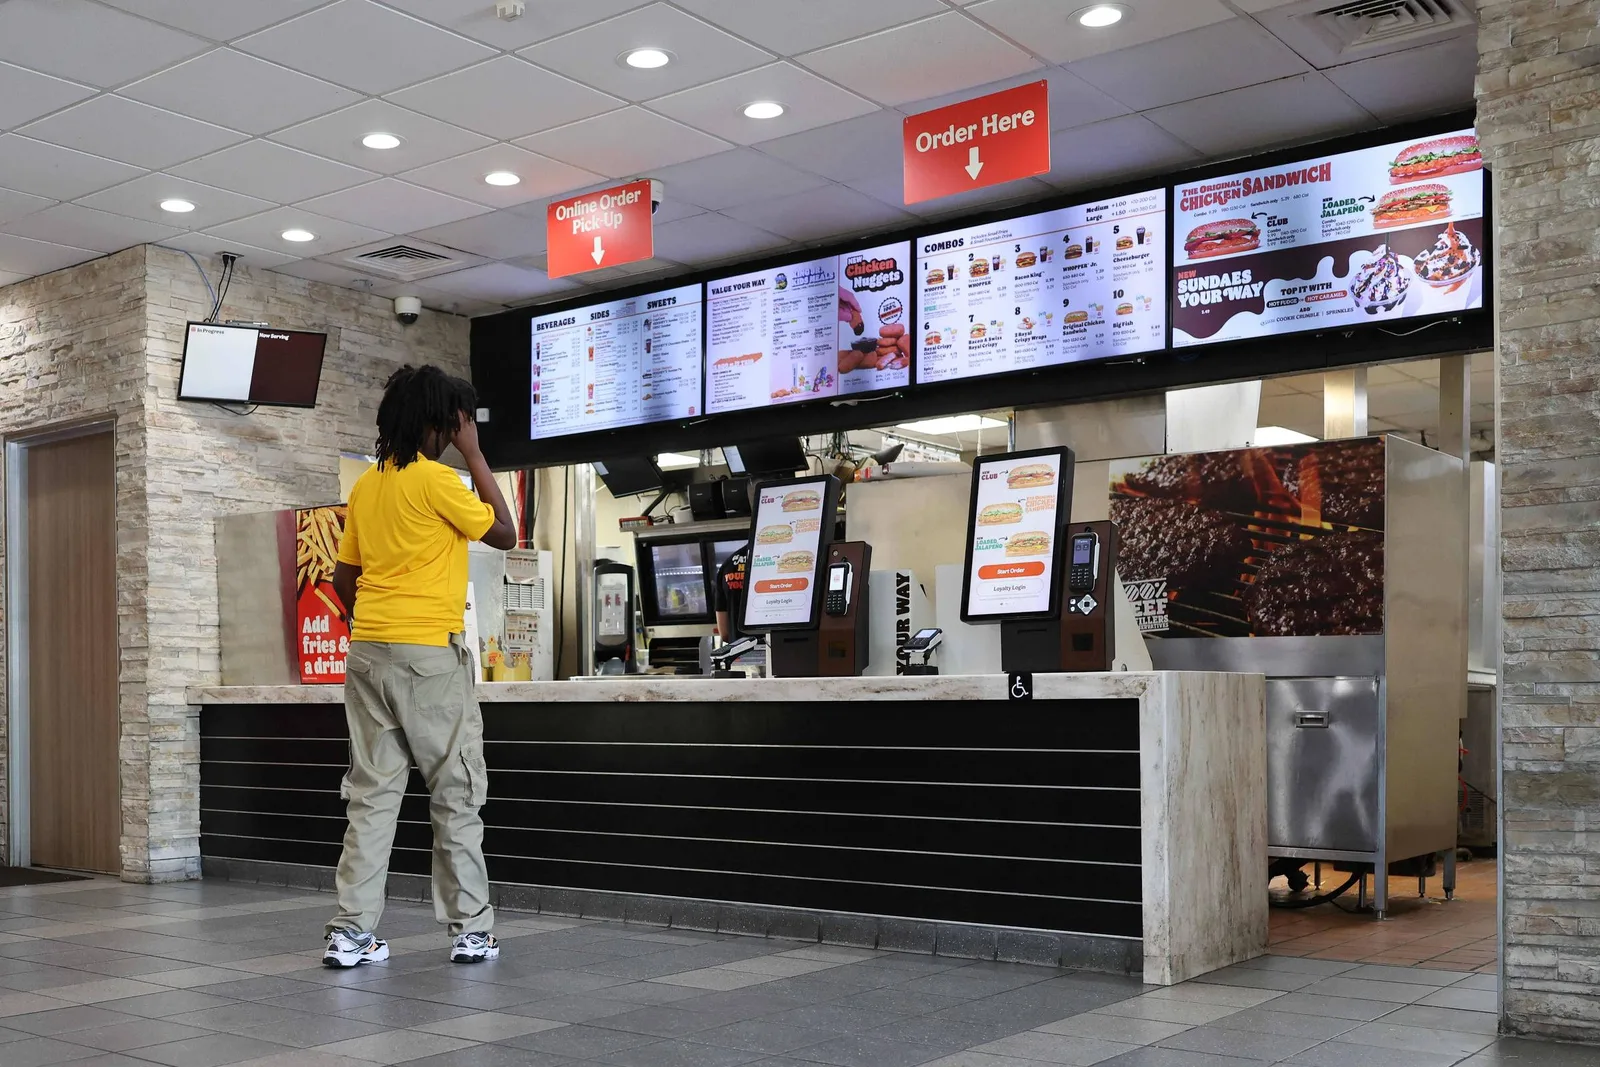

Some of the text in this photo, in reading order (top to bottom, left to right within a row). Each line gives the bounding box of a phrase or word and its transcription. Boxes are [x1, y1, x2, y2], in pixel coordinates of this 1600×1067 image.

[916, 110, 1034, 152] Order Here
[1180, 162, 1332, 212] CHICKEN SANDWICH
[1182, 180, 1241, 196] THE ORIGINAL
[556, 190, 641, 221] Online Order
[1322, 198, 1356, 209] LOADED
[1086, 205, 1109, 213] Medium
[1320, 204, 1364, 218] JALAPEÑO
[573, 212, 622, 234] Pick-Up
[1086, 214, 1102, 222] Large
[1267, 218, 1288, 227] CLUB
[1113, 225, 1119, 234] 5
[1063, 234, 1070, 243] 4
[924, 238, 964, 253] COMBOS
[1015, 244, 1020, 253] 3
[848, 256, 863, 264] NEW
[969, 253, 974, 261] 2
[1113, 253, 1150, 263] Cheeseburger
[847, 260, 894, 276] Chicken
[924, 262, 928, 270] 1
[1063, 263, 1088, 272] WHOPPER
[1178, 270, 1196, 279] NEW
[854, 271, 900, 289] Nuggets
[1178, 269, 1252, 294] SUNDAES
[712, 279, 766, 295] VALUE YOUR WAY
[924, 285, 946, 293] WHOPPER
[1281, 287, 1298, 296] TOP
[1309, 282, 1332, 291] WITH
[1113, 289, 1124, 299] 10
[1178, 281, 1264, 308] YOUR WAY
[1319, 292, 1345, 300] CARAMEL
[647, 297, 676, 309] SWEETS
[1063, 299, 1069, 307] 9
[590, 310, 610, 320] SIDES
[1015, 307, 1020, 315] 8
[1326, 307, 1354, 315] SPRINKLES
[969, 314, 974, 322] 7
[536, 317, 576, 331] BEVERAGES
[924, 322, 930, 330] 6
[1063, 322, 1083, 330] Original
[271, 333, 289, 341] Serving
[1063, 328, 1087, 336] Sandwich
[896, 572, 910, 615] WAY
[1124, 582, 1167, 602] 00%
[1132, 598, 1168, 616] EEF
[302, 614, 330, 634] Add
[1138, 614, 1168, 626] ILLERS
[303, 635, 350, 654] fries &
[305, 661, 312, 675] a
